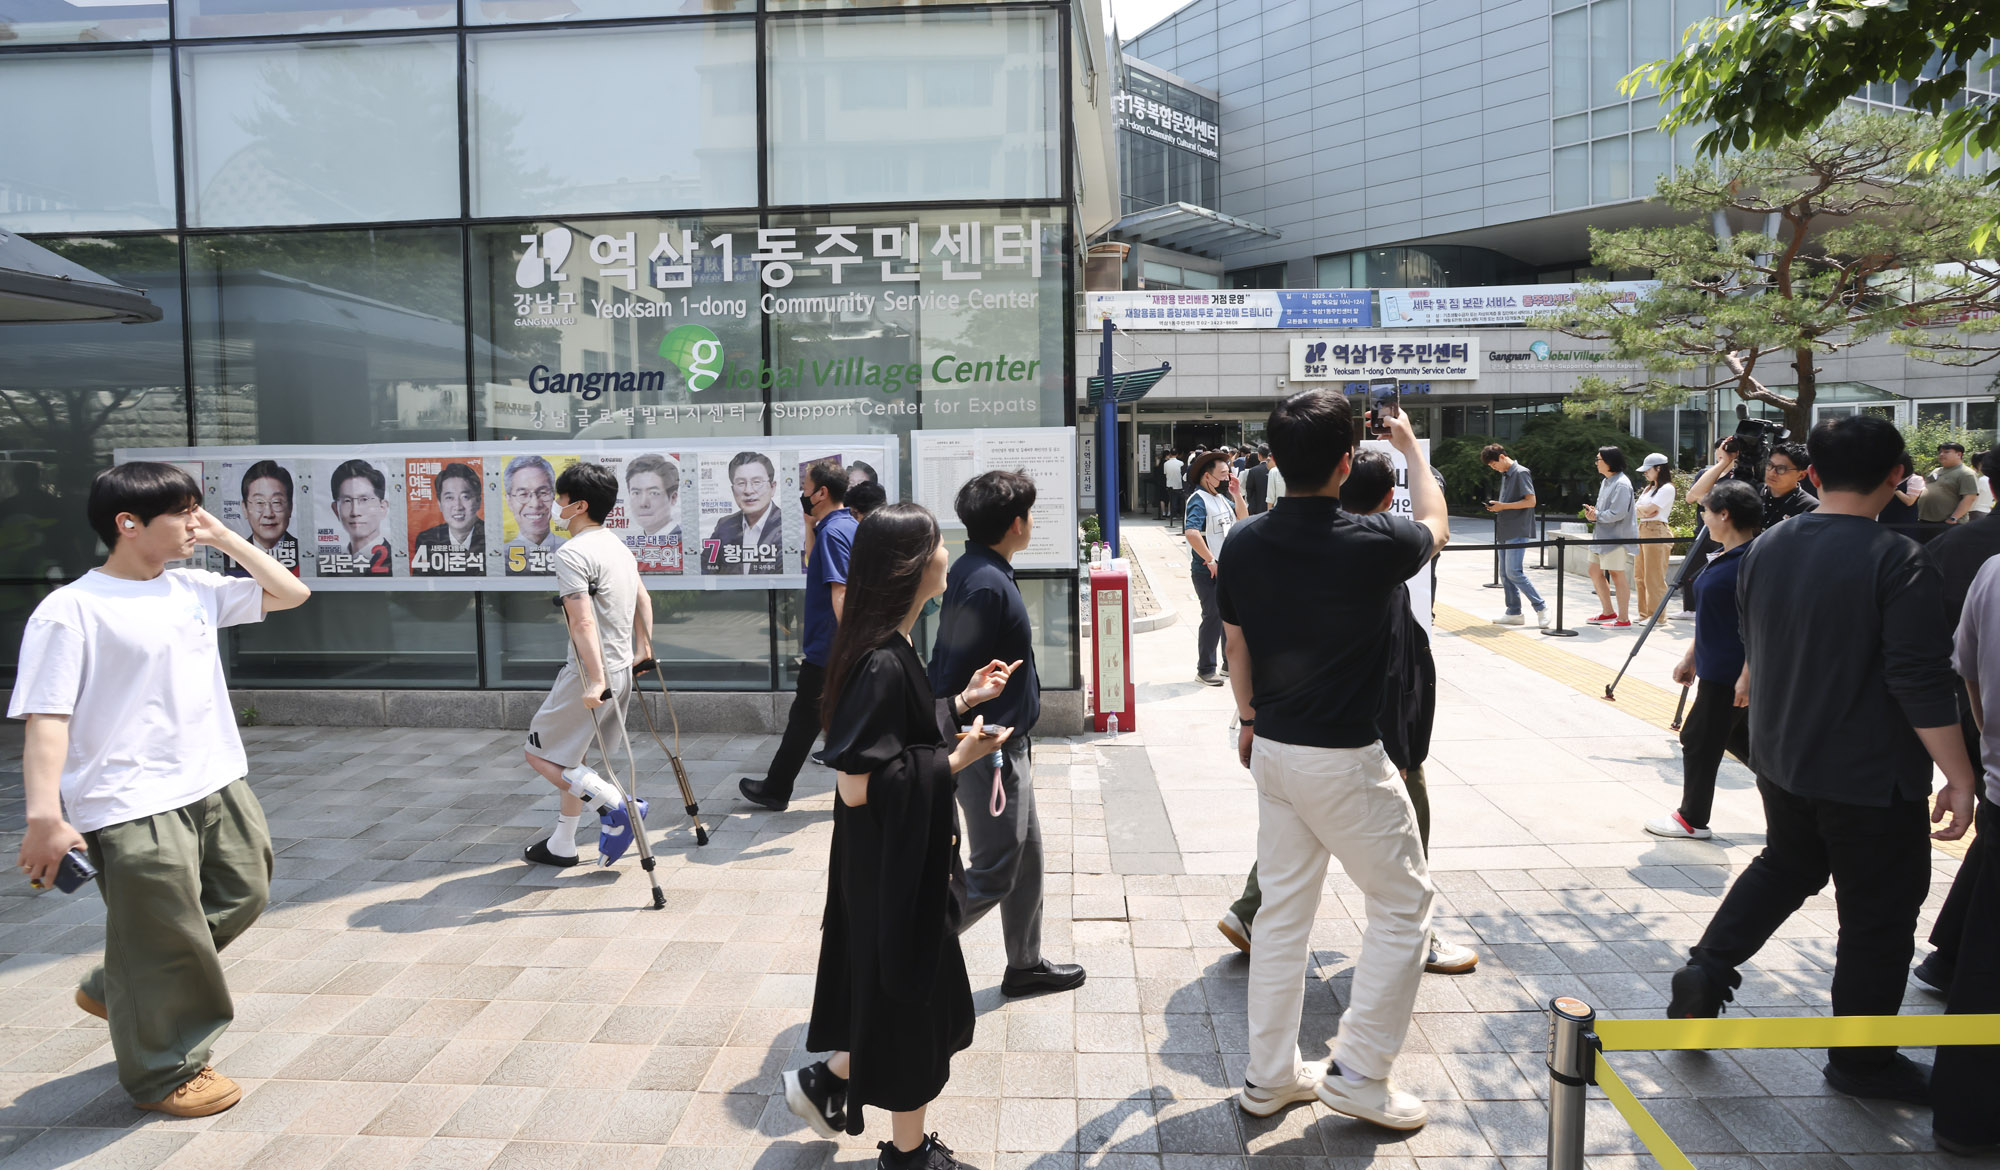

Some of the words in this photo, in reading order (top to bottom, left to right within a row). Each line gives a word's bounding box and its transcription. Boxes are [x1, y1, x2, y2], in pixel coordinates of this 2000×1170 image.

[1146, 126, 1176, 145] Community
[1176, 136, 1197, 151] Cultural
[1197, 144, 1218, 159] Complex
[588, 219, 1042, 290] 역삼1동주민센터
[513, 293, 577, 316] 강남구
[591, 297, 672, 319] Yeoksam
[680, 296, 747, 319] 1-dong
[760, 291, 876, 315] Community
[883, 289, 960, 313] Service
[968, 288, 1039, 310] Center
[1211, 294, 1227, 305] 거점
[1412, 298, 1433, 310] 세탁
[1462, 297, 1485, 309] 보관
[1485, 296, 1517, 308] 서비스
[1241, 307, 1273, 318] 드립니다
[1332, 342, 1469, 364] 역삼1동주민센터
[1489, 351, 1531, 363] Gangnam
[528, 364, 665, 400] Gangnam
[812, 356, 922, 394] Village
[931, 355, 1041, 384] Center
[1304, 364, 1328, 374] 강남구
[1333, 367, 1361, 376] Yeoksam
[1362, 367, 1385, 377] 1-dong
[1385, 366, 1421, 377] Community
[1421, 366, 1445, 375] Service
[1445, 366, 1467, 375] Center
[529, 404, 747, 429] 강남글로벌빌리지센터
[774, 401, 852, 421] Support
[860, 400, 923, 417] Center
[935, 399, 960, 414] for
[969, 398, 1037, 415] Expats
[409, 475, 431, 488] 여는
[1083, 452, 1092, 491] 역삼도서관
[409, 488, 432, 501] 선택
[605, 518, 629, 529] 교체!
[318, 554, 371, 573] 김문수
[370, 544, 389, 573] 2
[411, 544, 431, 573] 4
[431, 552, 484, 572] 이준석
[508, 545, 527, 572] 5
[703, 538, 721, 564] 7
[723, 543, 778, 563] 황교안
